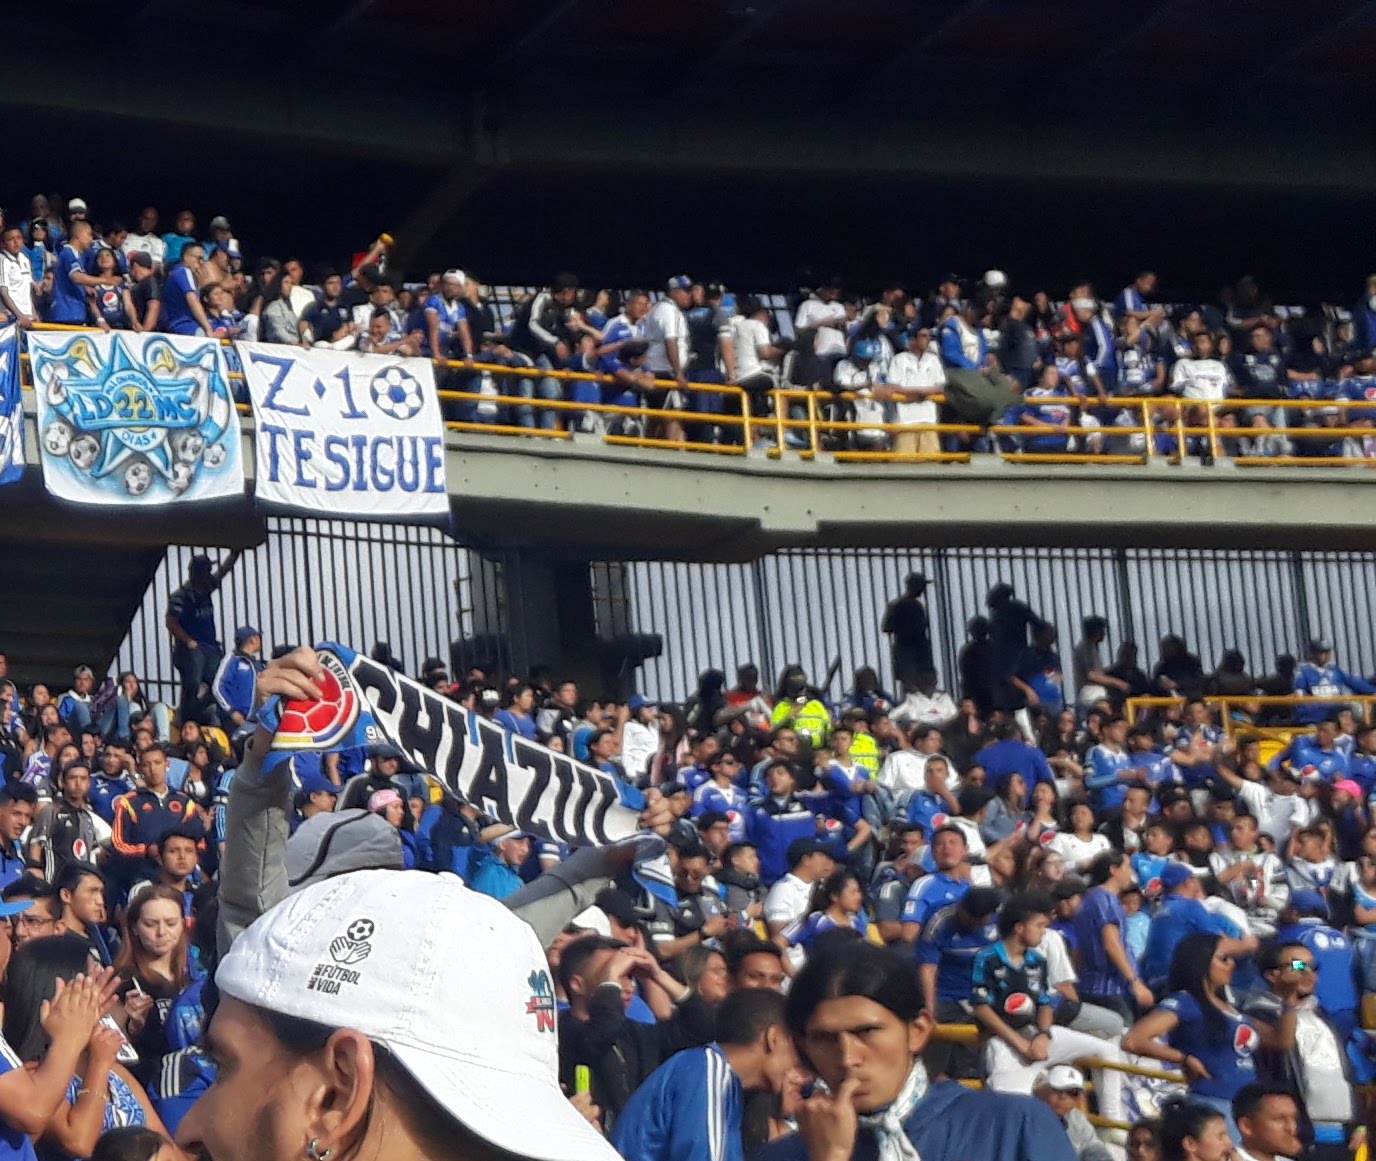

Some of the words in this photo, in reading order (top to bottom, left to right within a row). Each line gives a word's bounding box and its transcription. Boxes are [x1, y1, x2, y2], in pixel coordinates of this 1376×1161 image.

[260, 421, 317, 488] TE
[323, 434, 446, 493] SIGUE
[316, 978, 342, 996] VIDA
